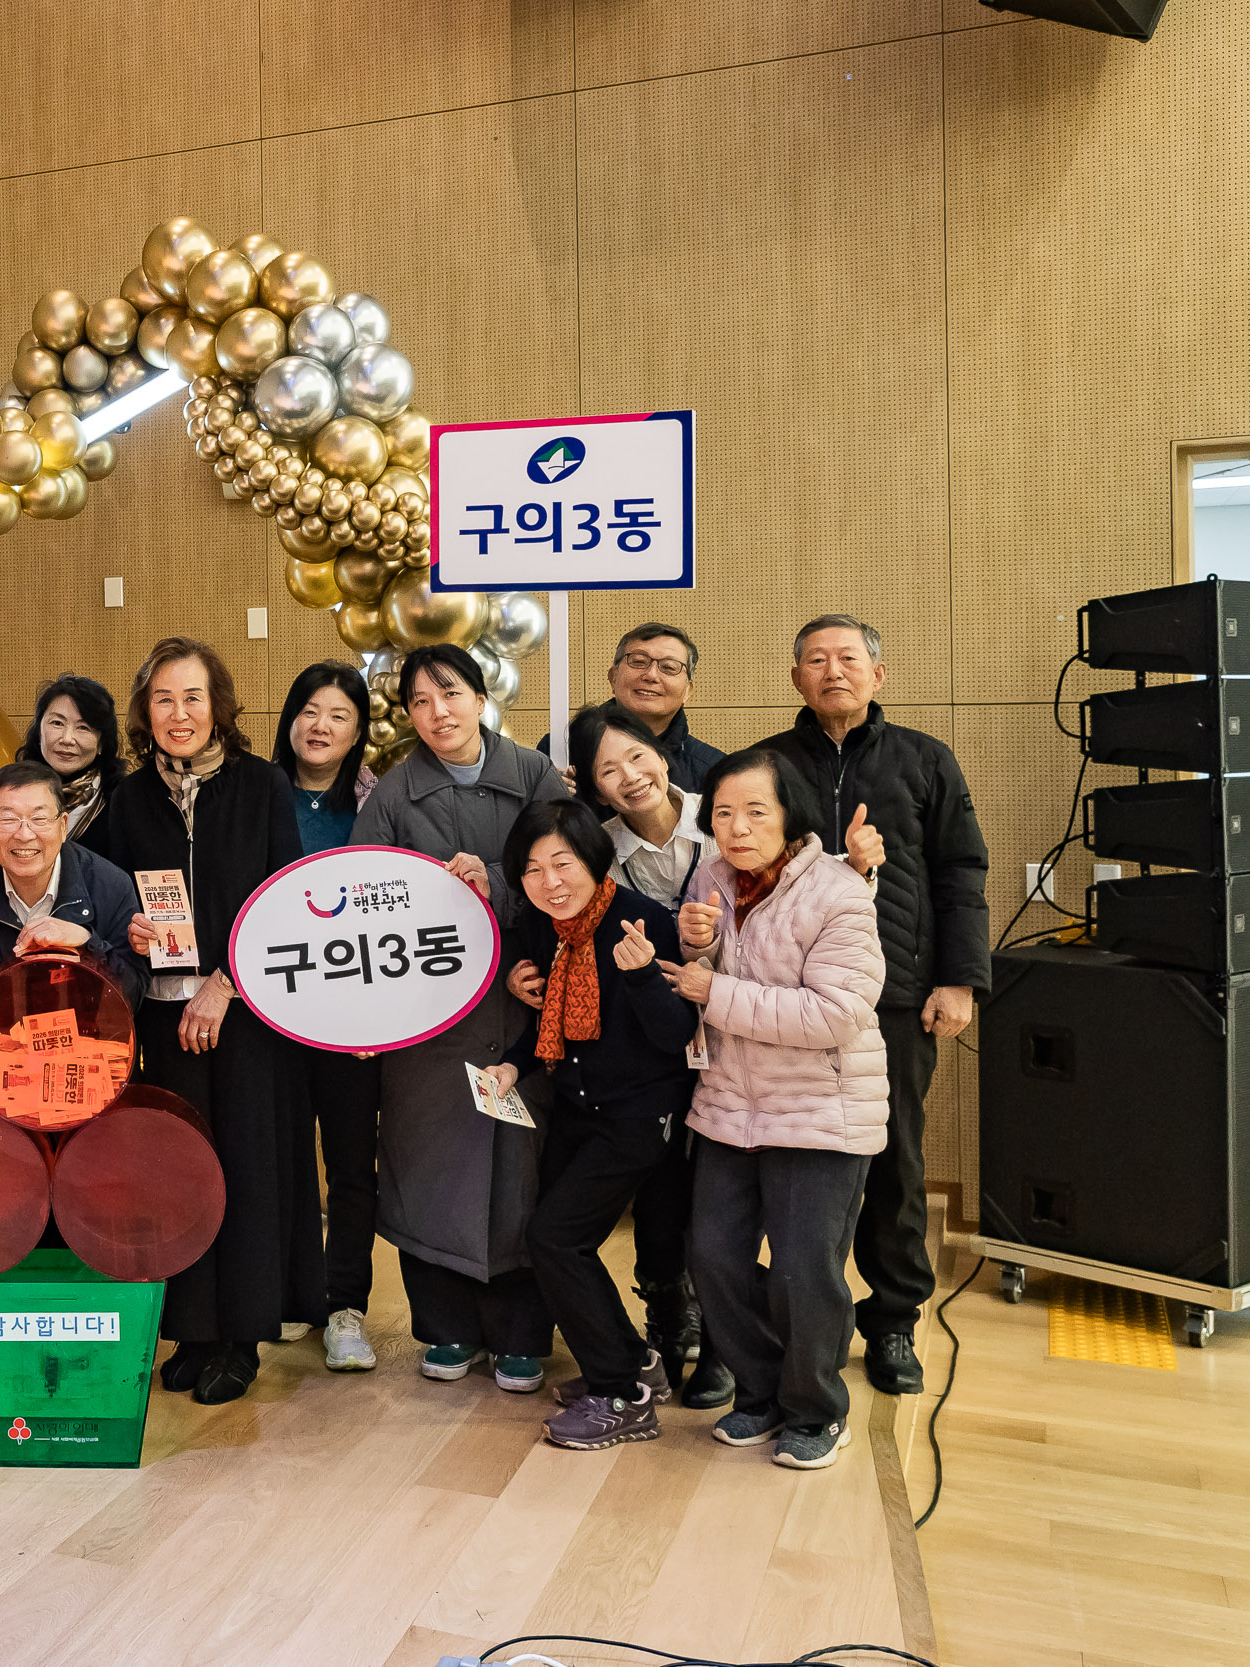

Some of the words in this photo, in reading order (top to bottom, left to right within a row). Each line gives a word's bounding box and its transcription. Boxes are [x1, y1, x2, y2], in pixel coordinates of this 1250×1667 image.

[459, 498, 661, 555] 구의3동
[145, 891, 182, 902] 따뜻한
[352, 882, 378, 895] 소통하며
[379, 879, 408, 893] 발전하는
[353, 891, 411, 914] 행복광진
[264, 924, 466, 993] 구의3동
[32, 1035, 73, 1051] 따뜻한
[65, 1064, 78, 1104] 따뜻한
